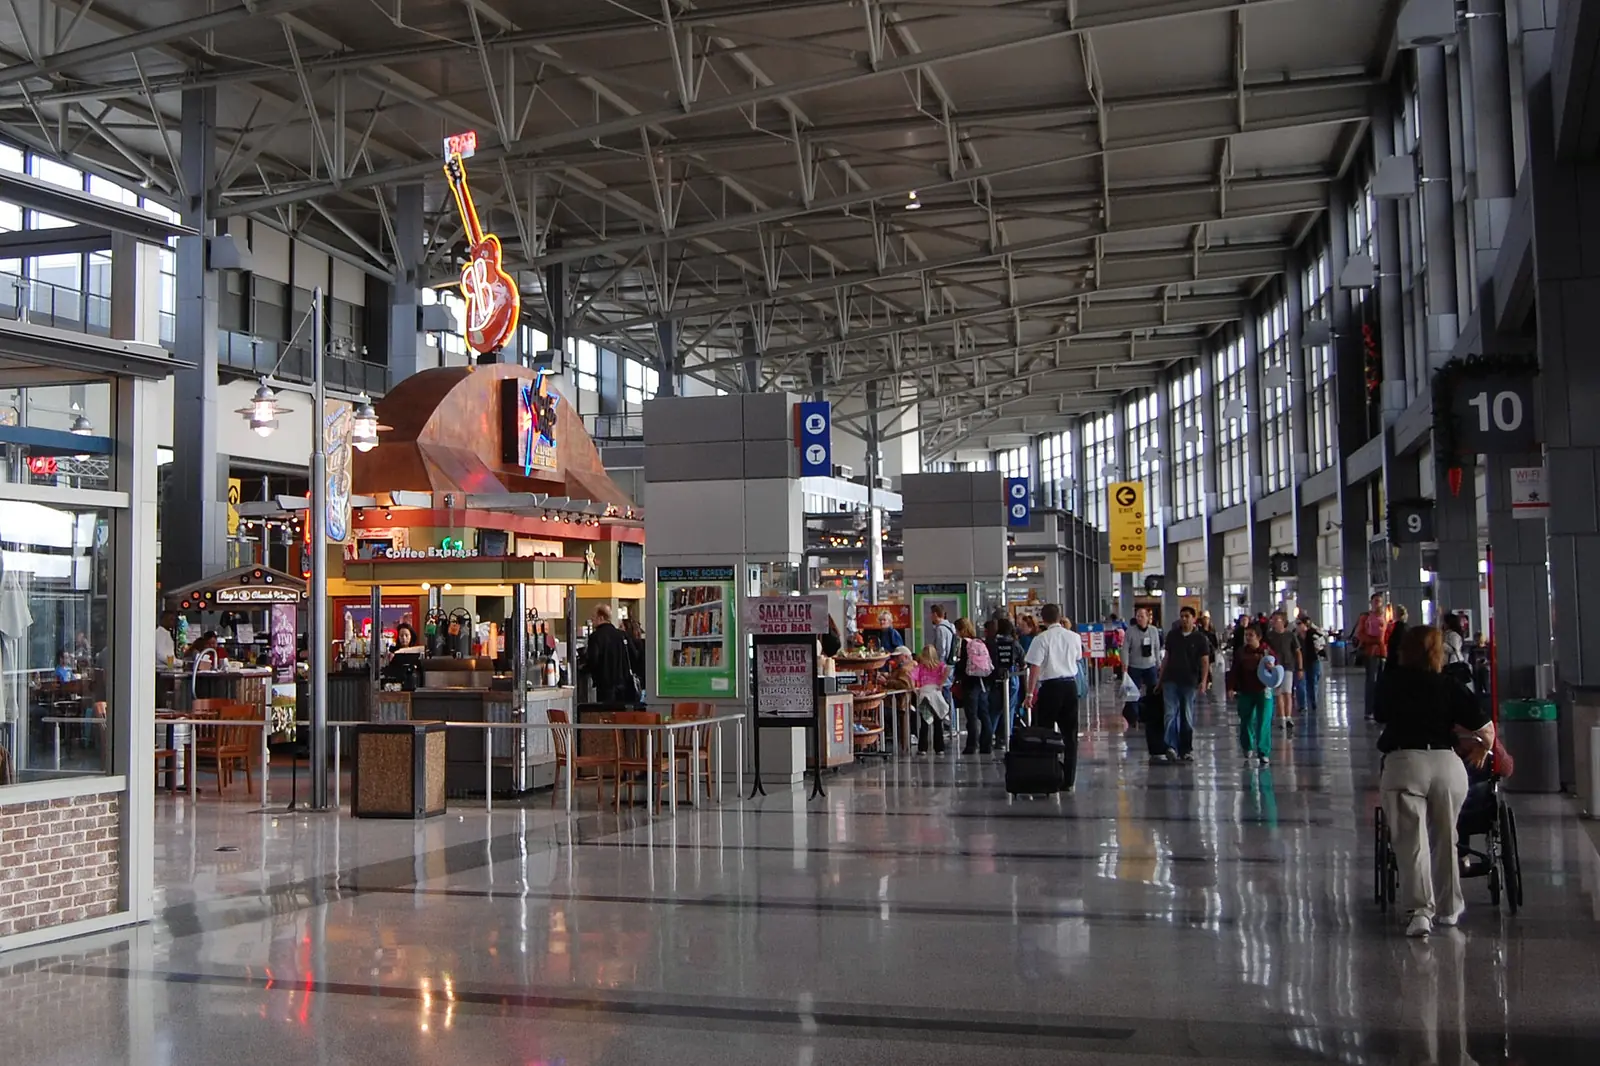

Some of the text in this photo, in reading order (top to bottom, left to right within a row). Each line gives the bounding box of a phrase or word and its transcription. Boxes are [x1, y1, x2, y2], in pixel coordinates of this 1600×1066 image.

[1469, 391, 1522, 431] 10
[1408, 514, 1421, 533] 9
[385, 547, 425, 559] Coffee
[427, 546, 478, 558] Express
[1280, 562, 1289, 572] 8
[759, 604, 812, 620] SALT LICK
[760, 623, 811, 632] TACO BAR
[763, 650, 806, 663] SALT LICK
